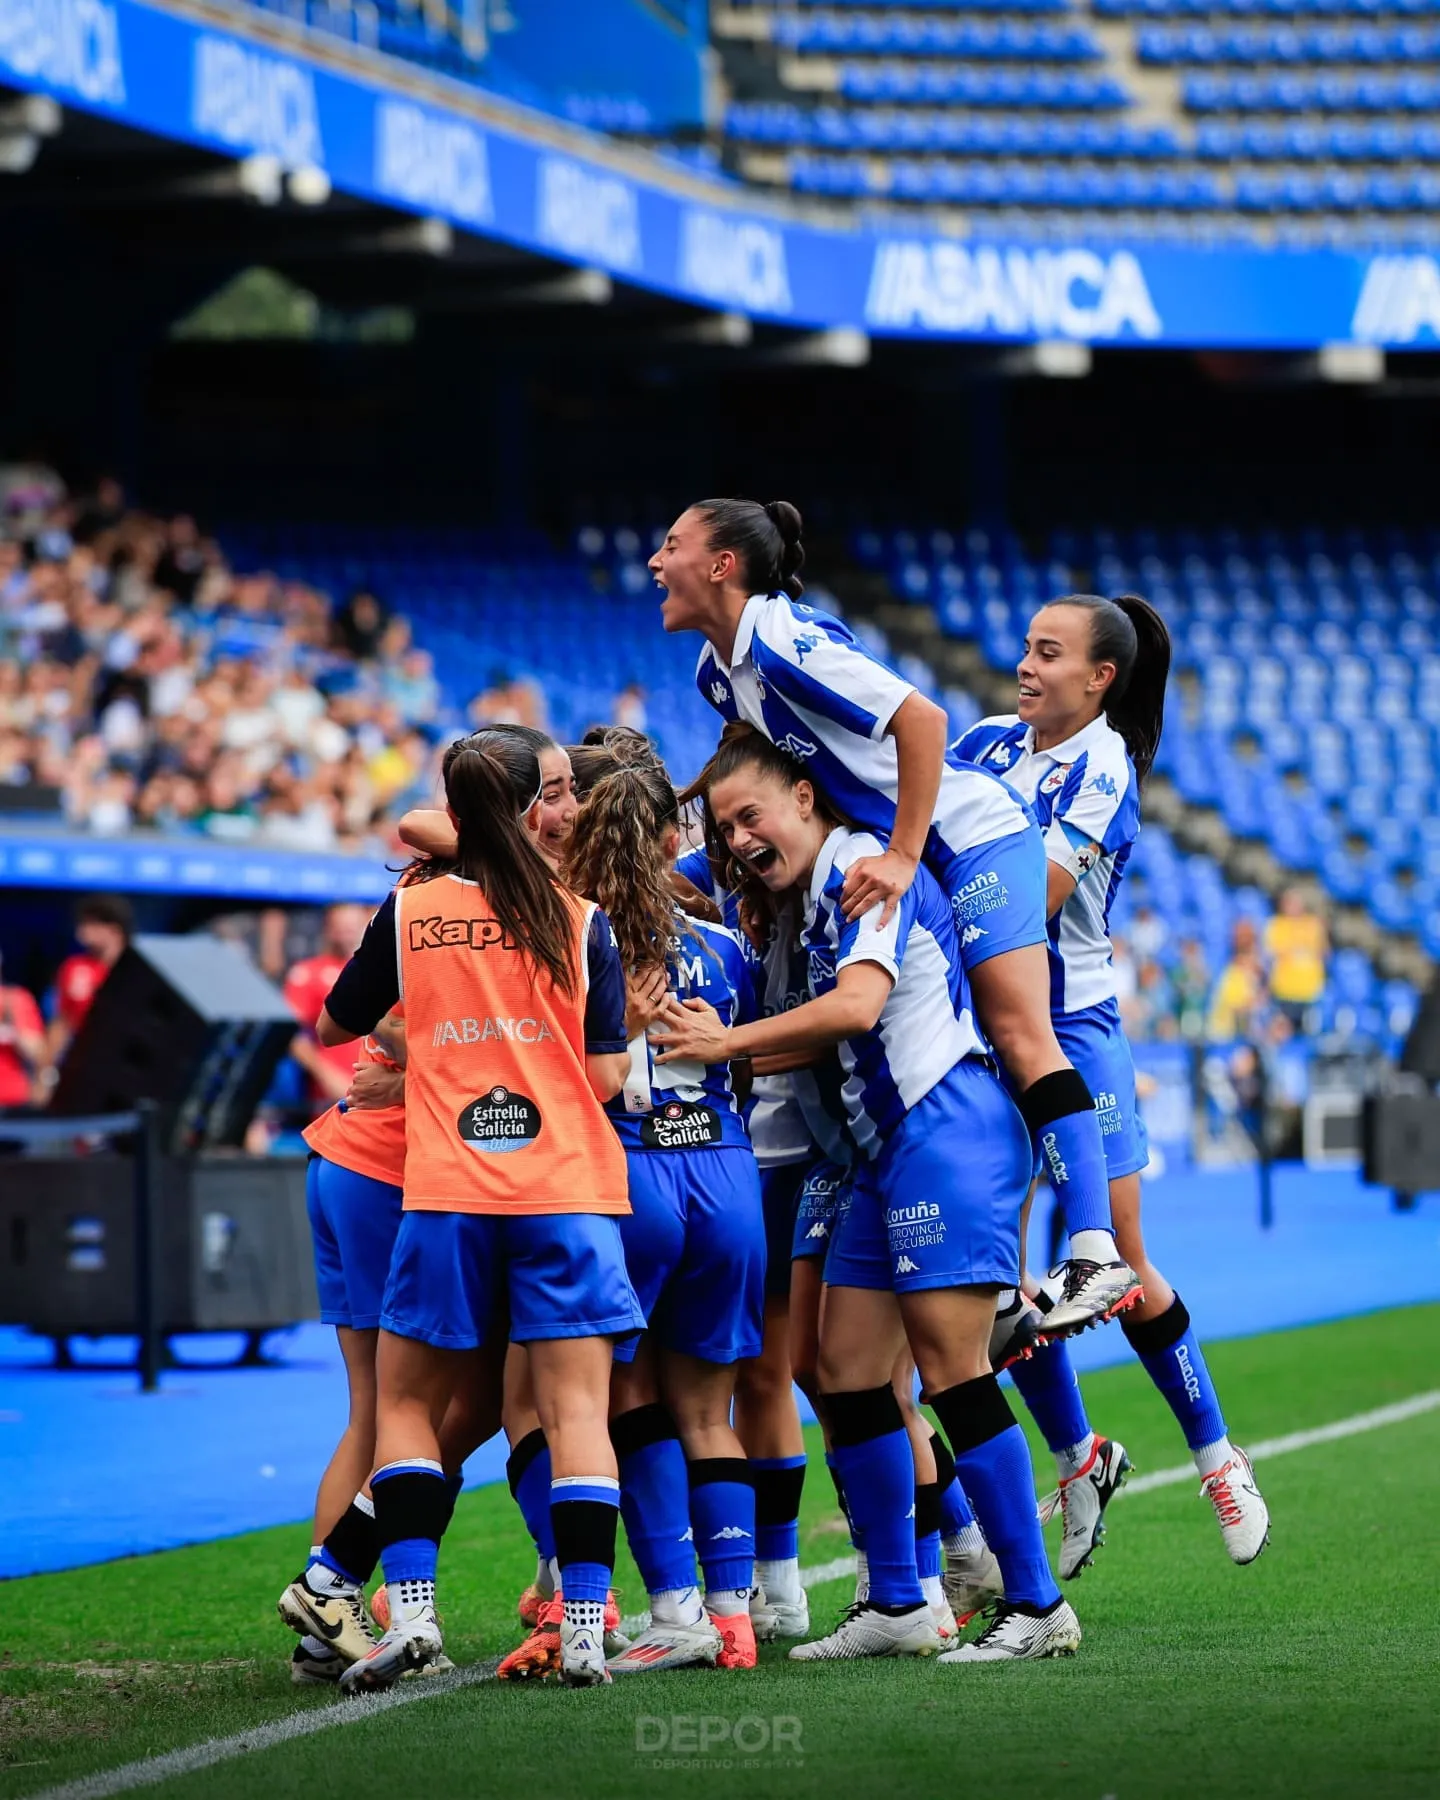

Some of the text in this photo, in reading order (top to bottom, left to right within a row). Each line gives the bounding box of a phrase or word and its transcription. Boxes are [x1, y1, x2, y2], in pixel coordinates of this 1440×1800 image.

[952, 871, 999, 908] oruña
[409, 916, 518, 951] Kap
[472, 1105, 528, 1121] Estrella
[653, 1111, 711, 1133] Estrella
[473, 1120, 526, 1137] Galicia
[658, 1126, 712, 1147] Galicia
